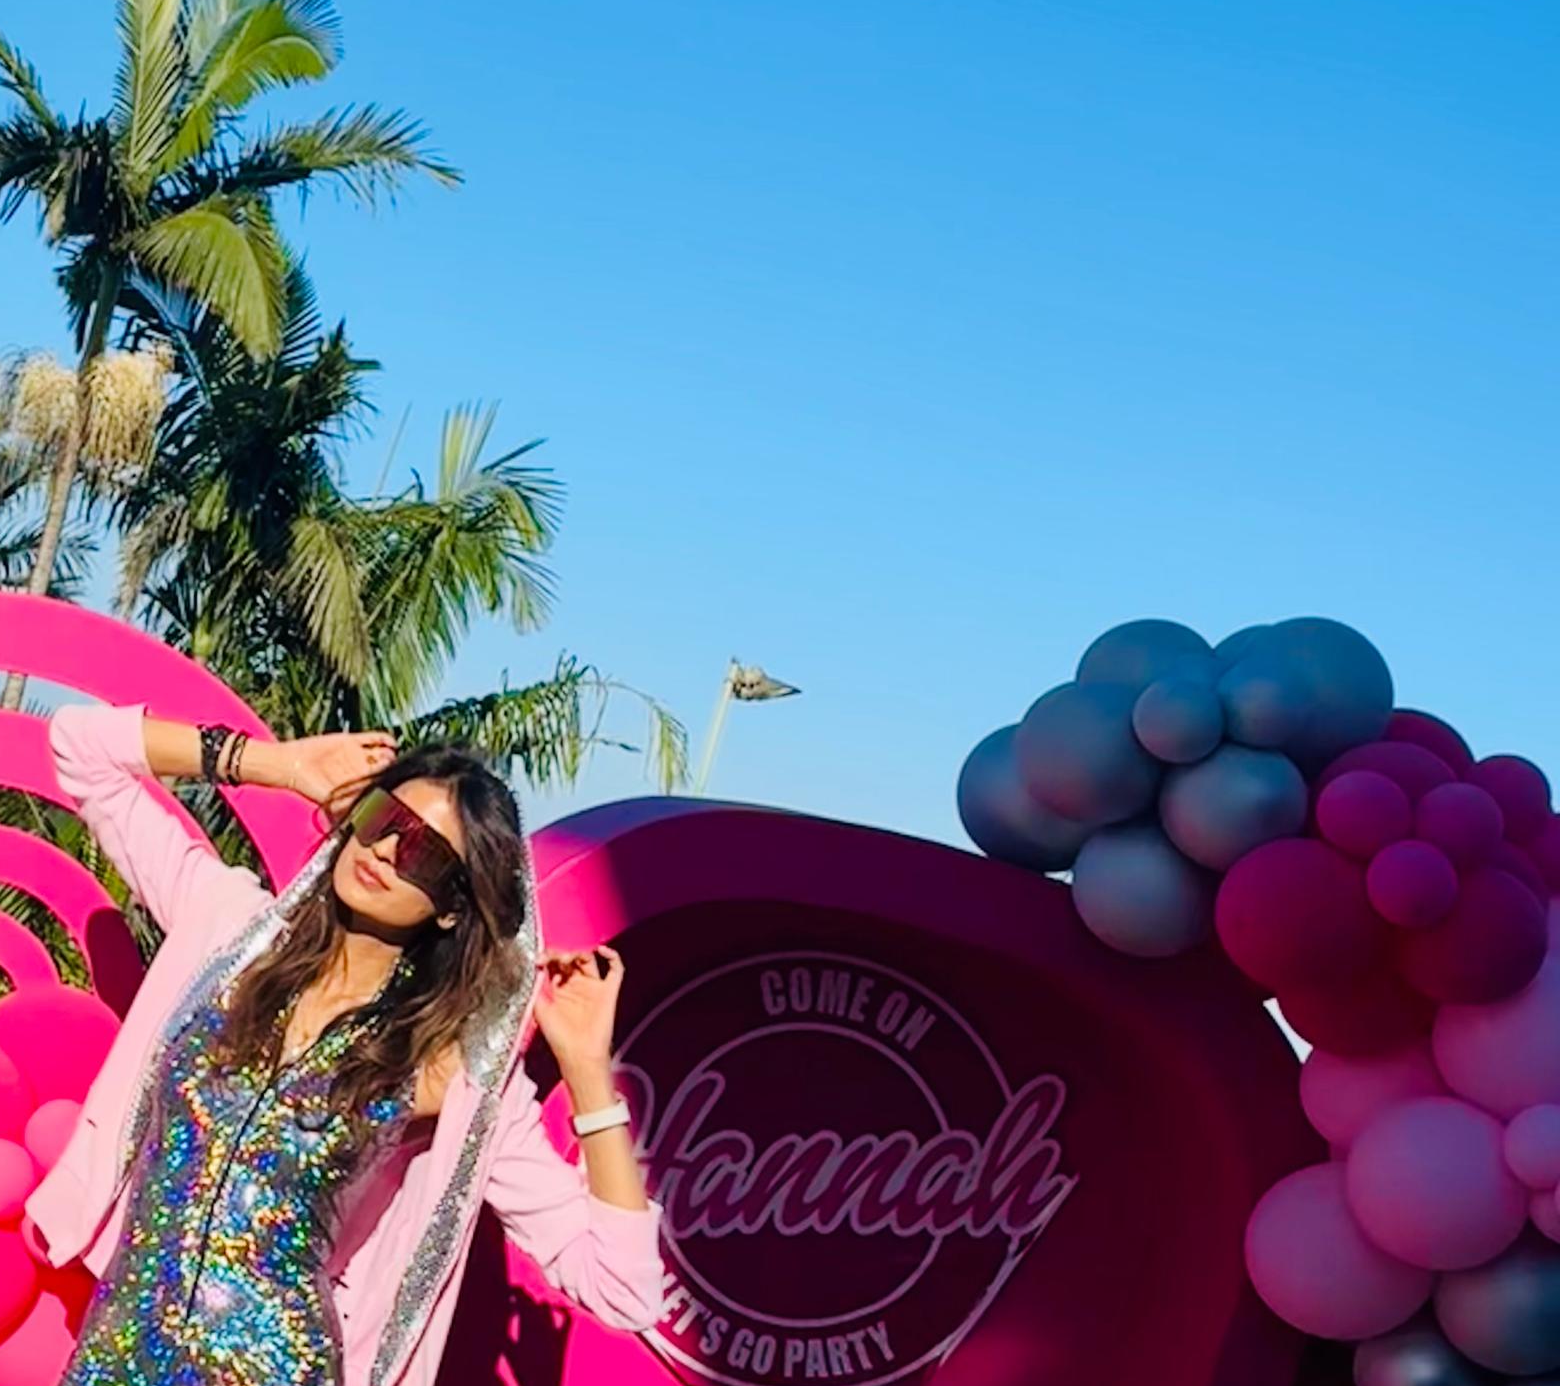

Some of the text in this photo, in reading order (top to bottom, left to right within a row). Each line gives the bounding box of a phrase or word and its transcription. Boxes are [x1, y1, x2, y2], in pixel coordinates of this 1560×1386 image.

[759, 967, 939, 1053] COME ON
[612, 1062, 1080, 1240] Hannah
[727, 1327, 773, 1377] GO
[783, 1321, 899, 1381] PARTY
